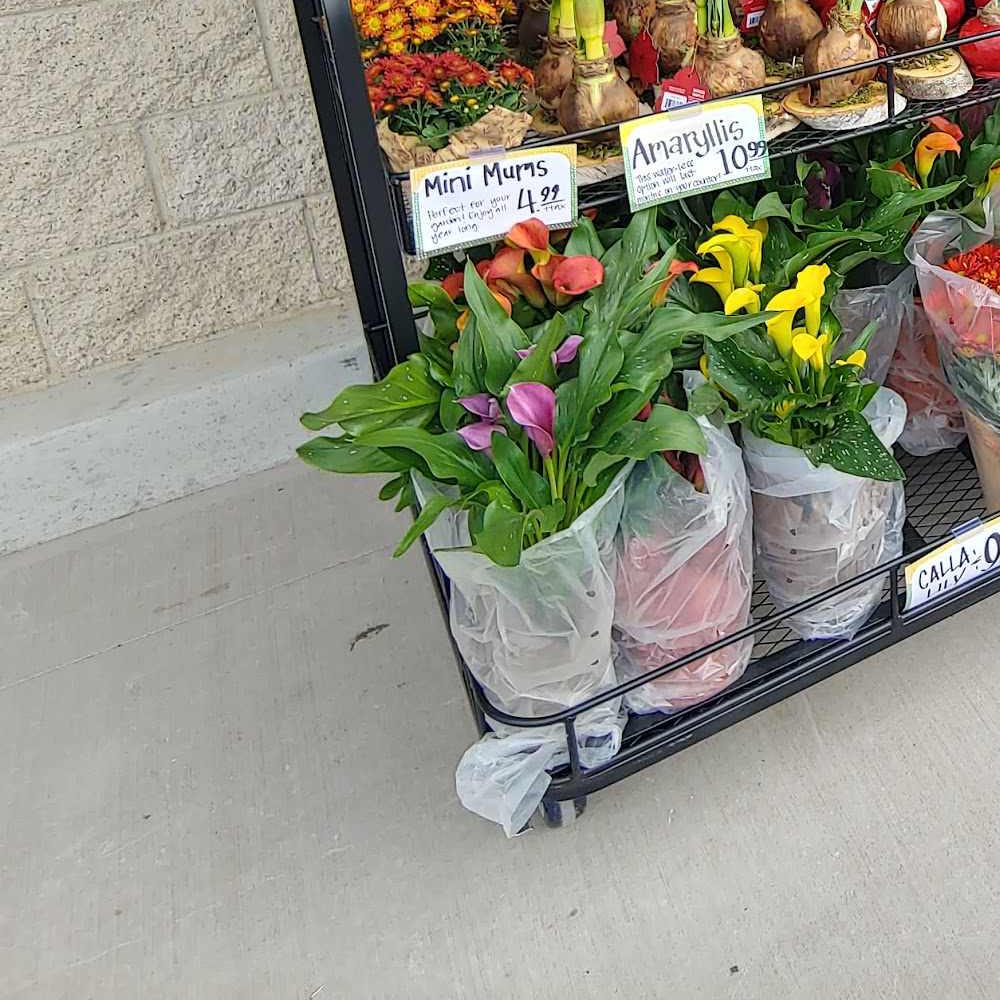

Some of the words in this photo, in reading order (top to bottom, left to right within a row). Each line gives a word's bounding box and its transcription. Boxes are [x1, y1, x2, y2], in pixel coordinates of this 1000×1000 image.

[633, 119, 744, 170] Amaryllis
[425, 166, 473, 198] Mini
[483, 160, 549, 187] Mums
[427, 204, 466, 221] Perfect
[490, 193, 512, 208] your
[468, 209, 494, 225] Enjoy
[495, 204, 508, 215] all
[431, 229, 453, 244] year
[918, 547, 970, 590] CALLA
